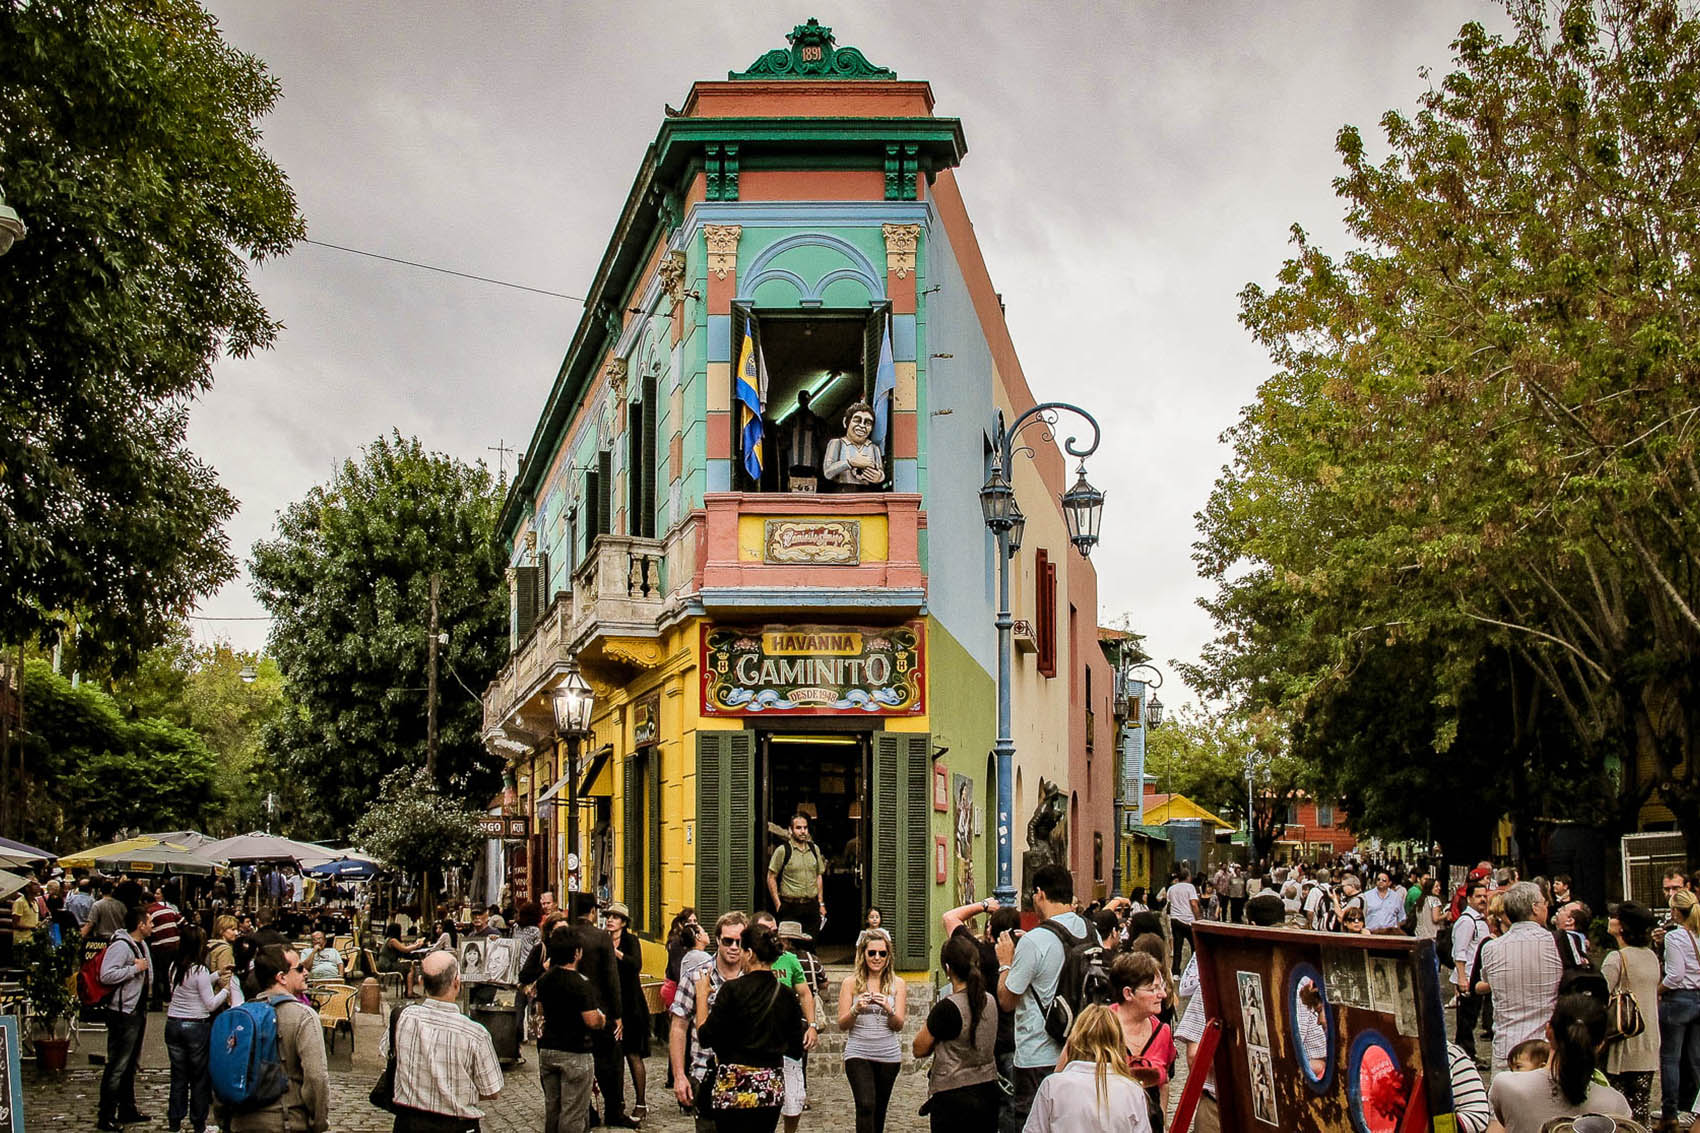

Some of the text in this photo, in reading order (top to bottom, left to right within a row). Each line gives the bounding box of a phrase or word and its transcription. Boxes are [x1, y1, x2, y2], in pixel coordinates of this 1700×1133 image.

[802, 47, 822, 61] 1891
[771, 635, 855, 652] HAVANNA
[735, 653, 892, 686] CAMINITO
[790, 689, 819, 701] DESDE
